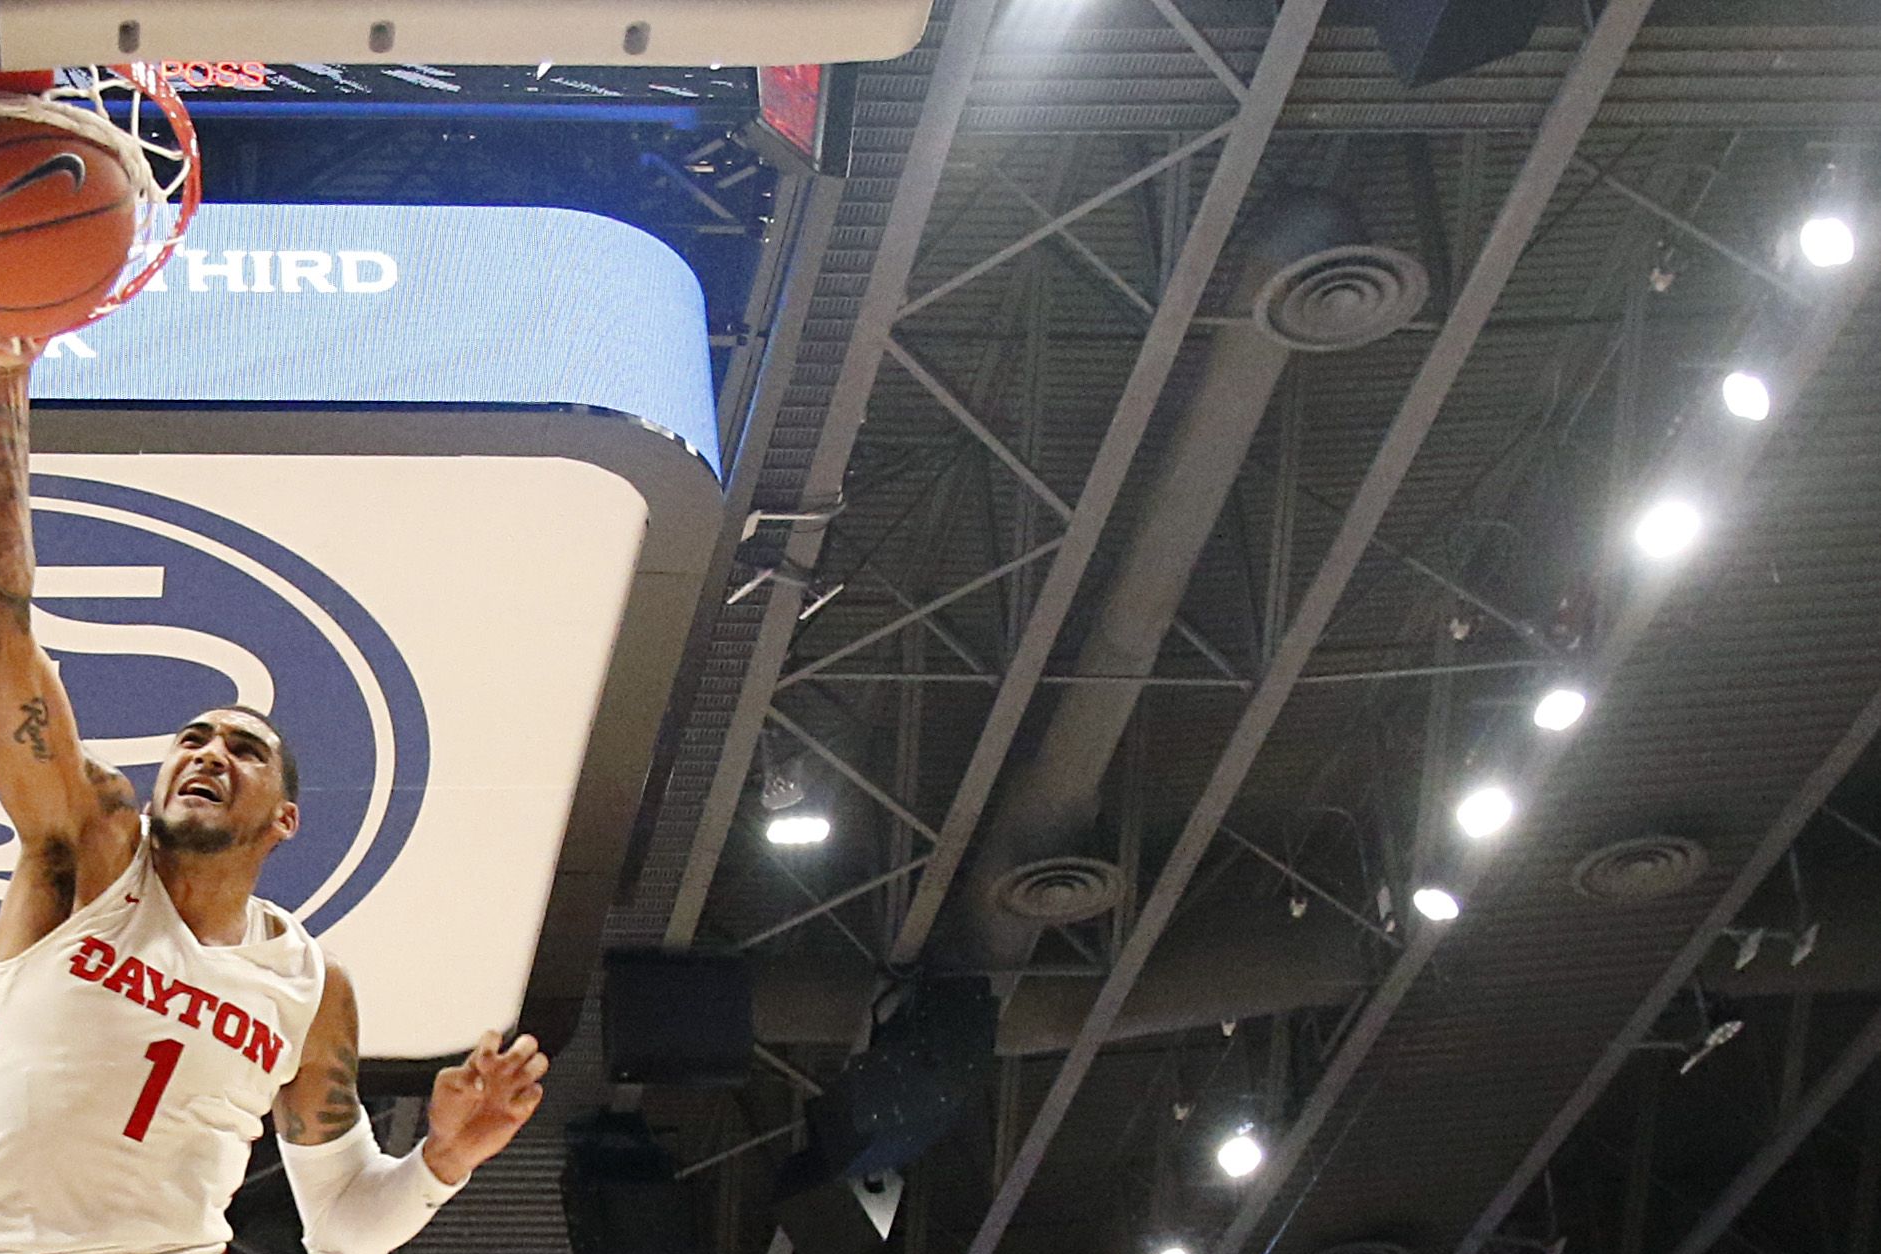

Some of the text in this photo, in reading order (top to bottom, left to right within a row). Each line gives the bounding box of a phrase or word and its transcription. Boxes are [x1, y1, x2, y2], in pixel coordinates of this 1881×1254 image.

[161, 61, 265, 88] POSS
[130, 242, 398, 294] THIRD
[69, 935, 284, 1074] DAYTON
[122, 1038, 185, 1143] 1
